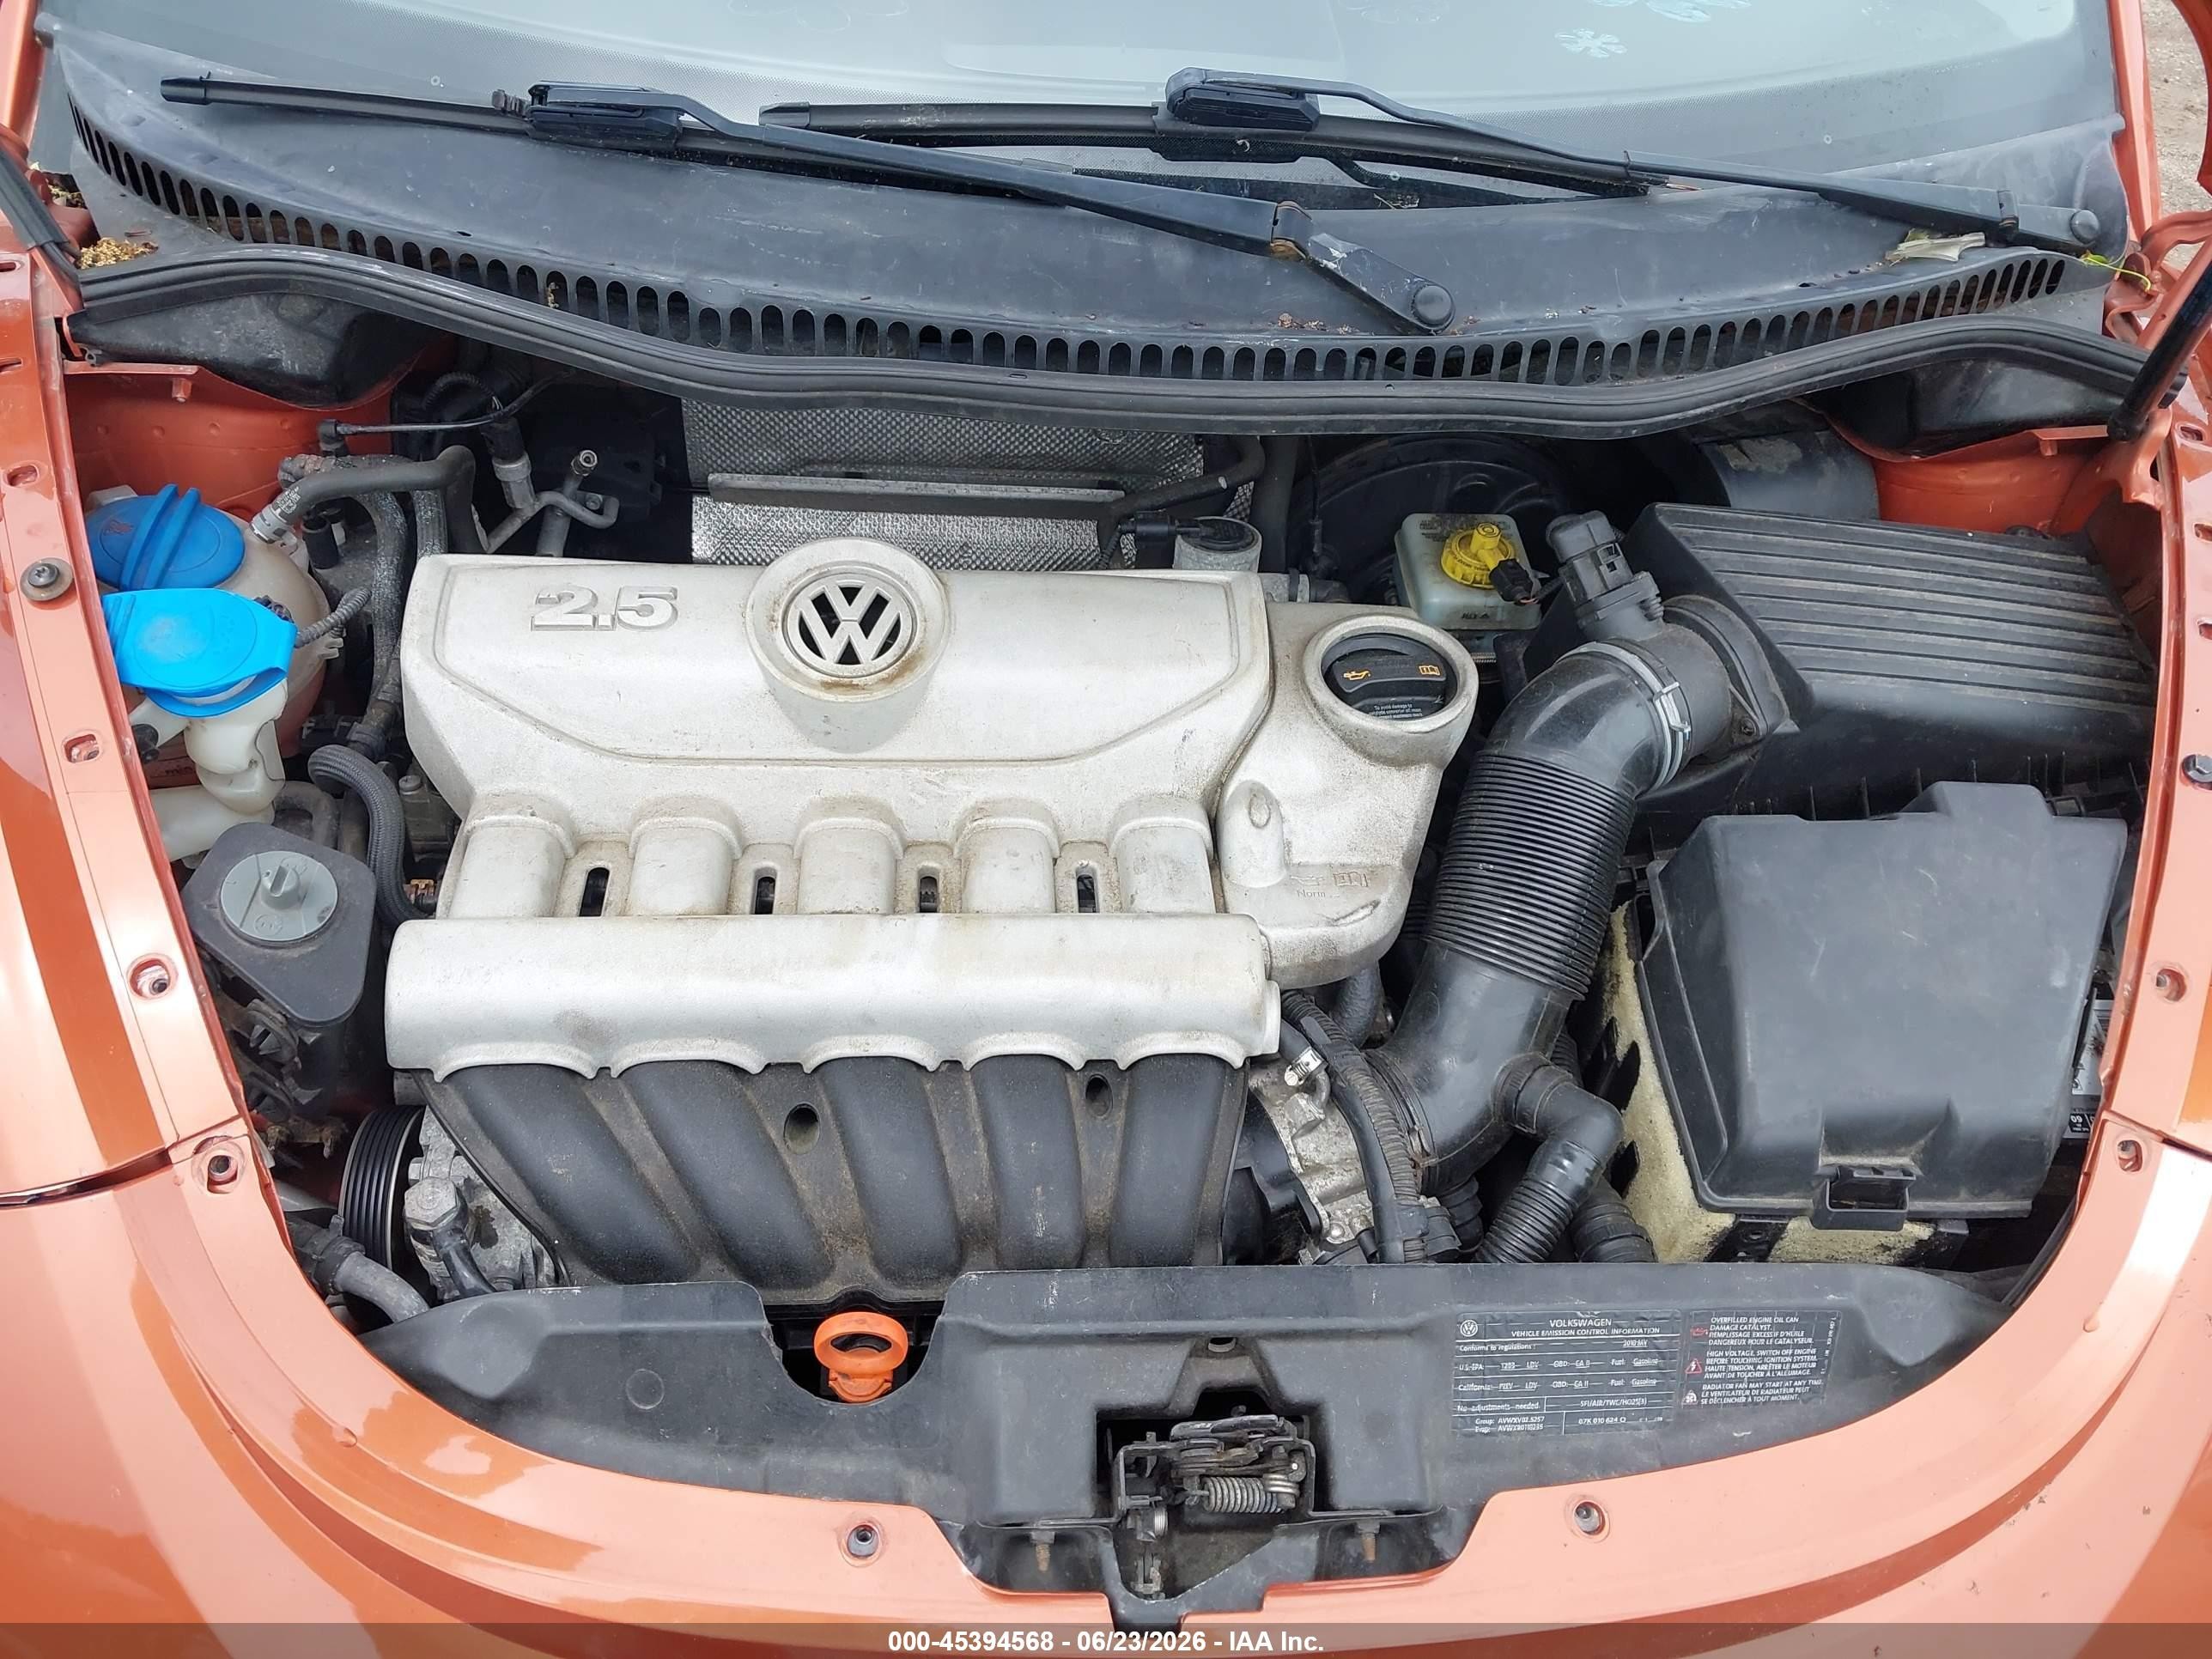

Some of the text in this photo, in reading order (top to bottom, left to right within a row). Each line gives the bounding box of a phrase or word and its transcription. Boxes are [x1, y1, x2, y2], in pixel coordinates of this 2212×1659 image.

[531, 584, 678, 631] 2.5
[1549, 1318, 1612, 1328] VOLKSWAGEN
[1470, 1404, 1510, 1413] adjustments
